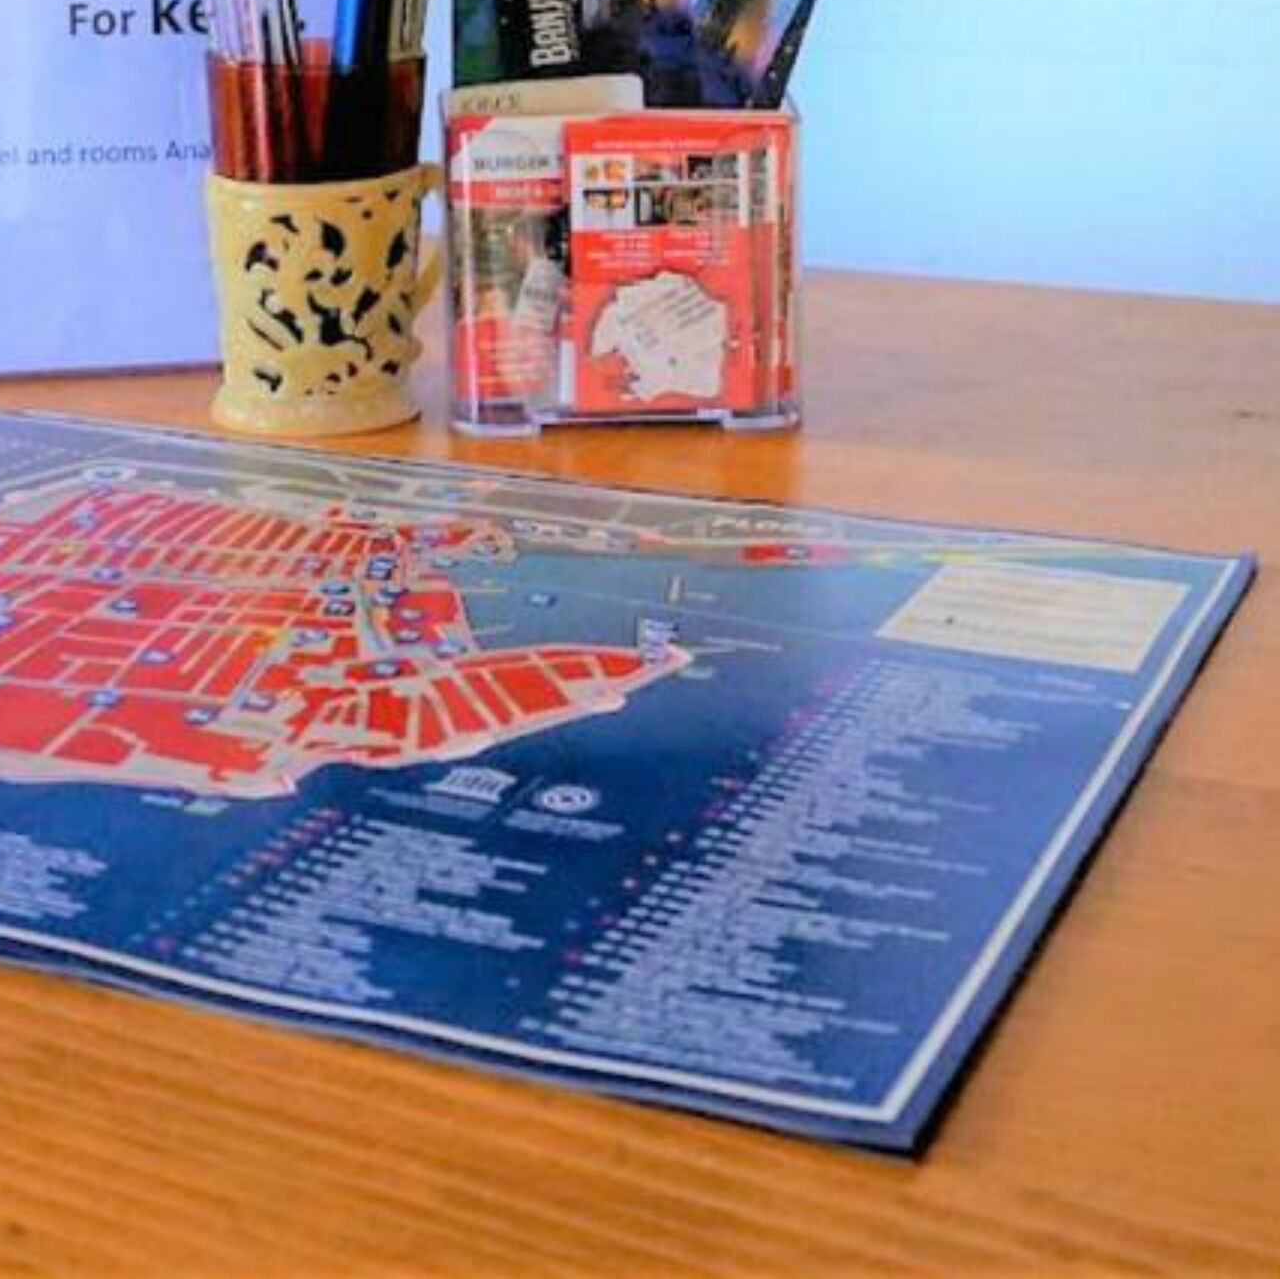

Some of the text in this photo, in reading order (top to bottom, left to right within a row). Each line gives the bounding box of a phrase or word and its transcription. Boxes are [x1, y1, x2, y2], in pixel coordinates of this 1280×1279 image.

[68, 2, 136, 36] For
[26, 145, 73, 166] and
[79, 143, 158, 165] rooms
